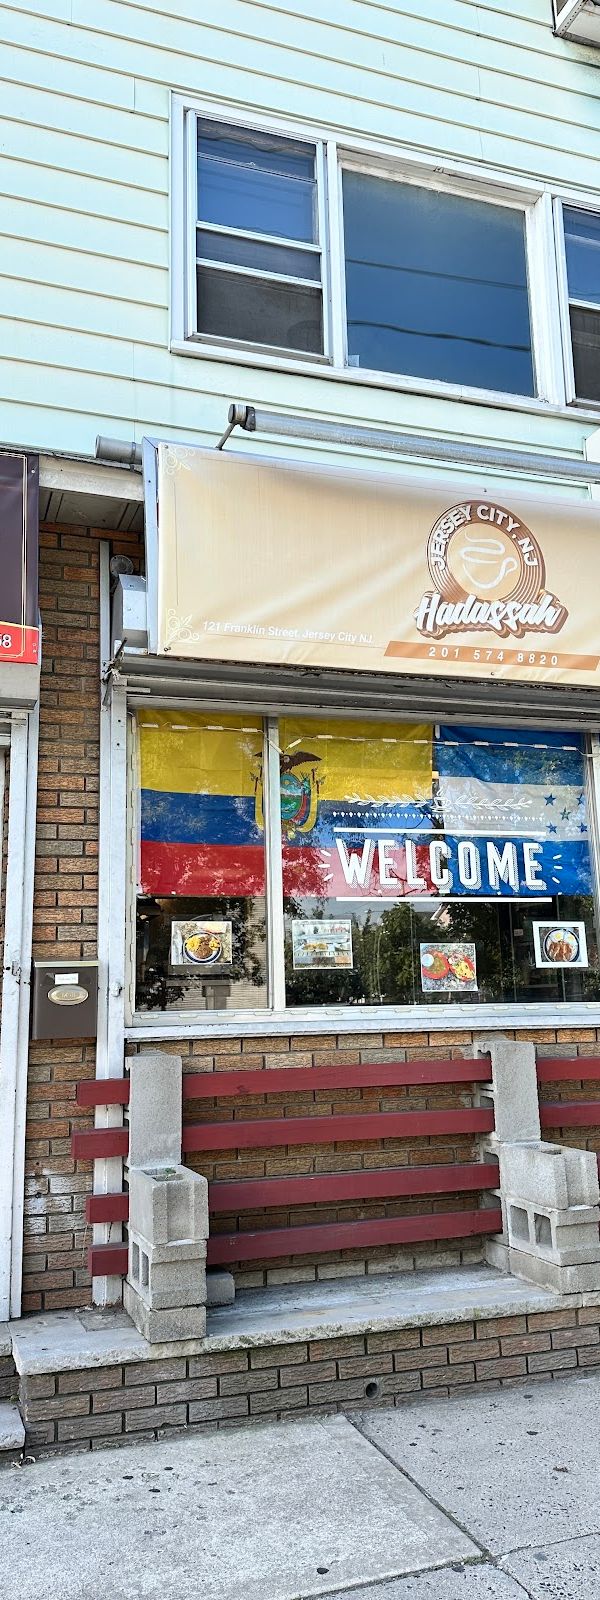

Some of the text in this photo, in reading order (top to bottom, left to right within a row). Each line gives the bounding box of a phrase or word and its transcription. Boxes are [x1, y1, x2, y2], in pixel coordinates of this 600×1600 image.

[430, 504, 472, 571] JERSEY
[517, 536, 539, 567] NJ
[203, 621, 221, 631] 121
[224, 623, 265, 635] Franklin
[302, 630, 336, 641] Jersey
[338, 632, 357, 644] City
[359, 634, 373, 644] NJ
[414, 592, 562, 633] Hadassah
[428, 646, 558, 666] 201 574 8820
[336, 838, 547, 891] WELCOME
